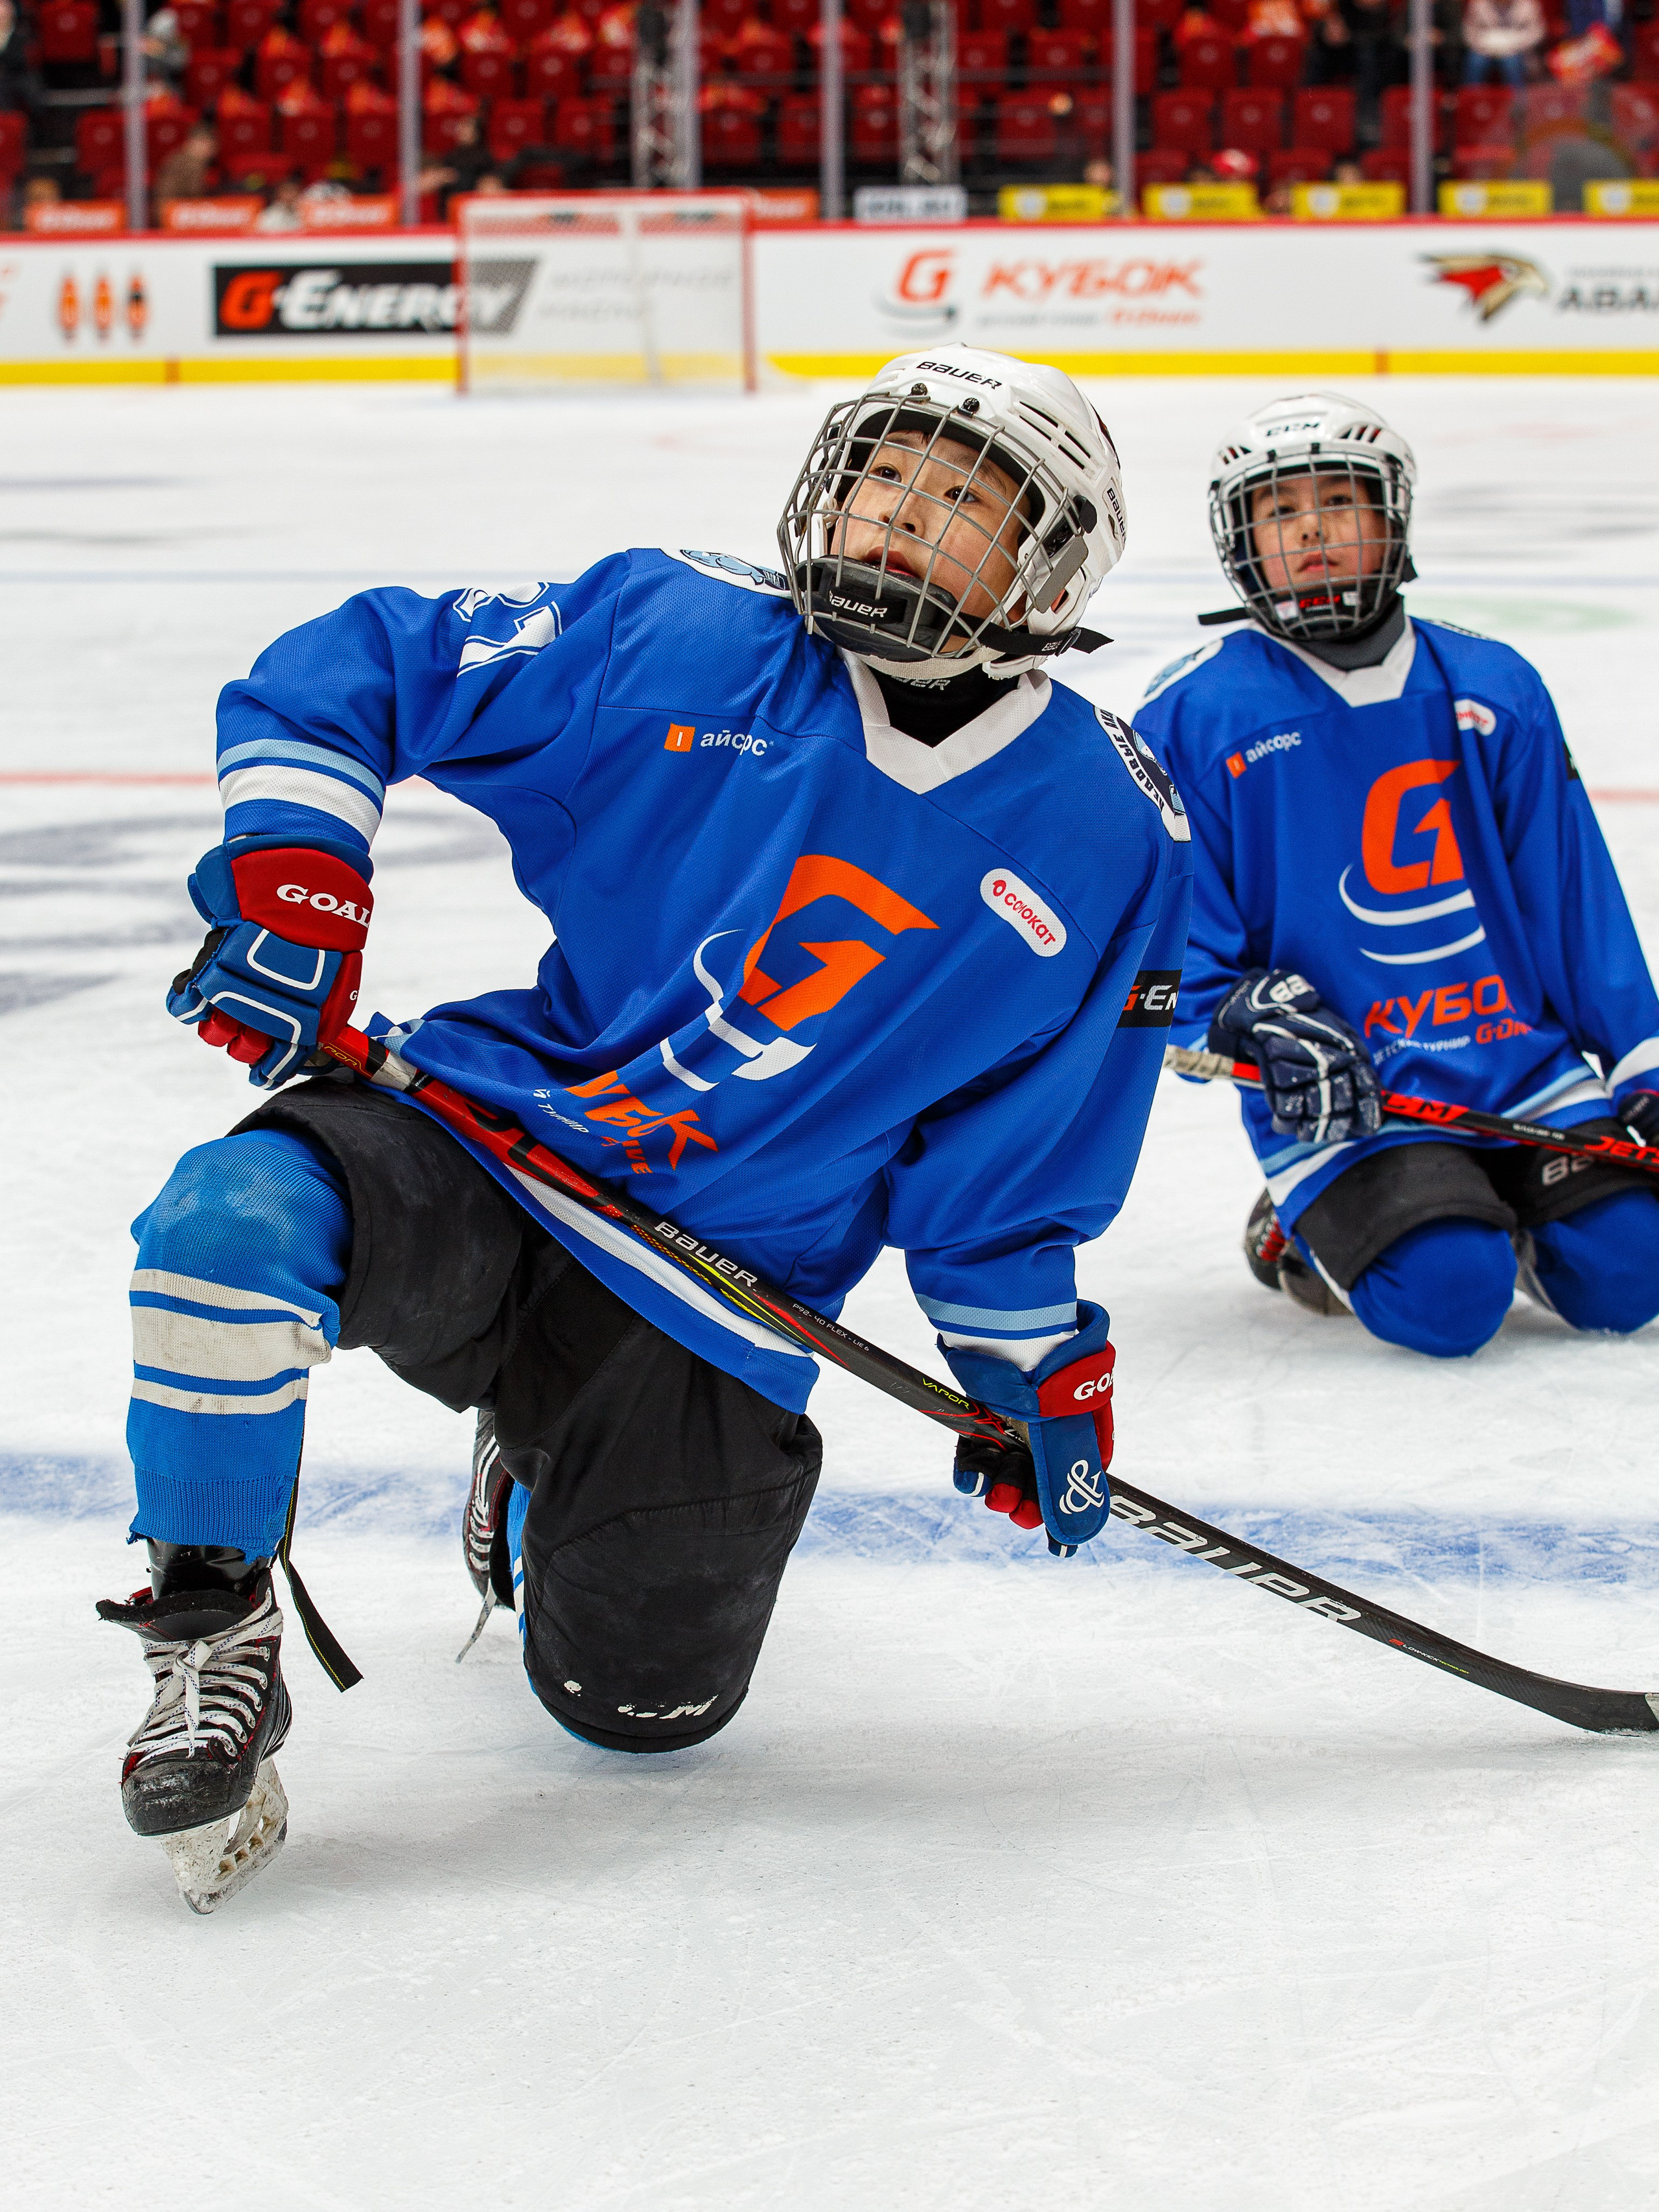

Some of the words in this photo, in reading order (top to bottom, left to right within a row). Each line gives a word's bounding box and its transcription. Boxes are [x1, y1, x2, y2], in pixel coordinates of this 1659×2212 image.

[980, 259, 1205, 303] КУБОК
[916, 361, 1003, 390] BAUER
[1266, 422, 1321, 437] CCM
[1246, 731, 1302, 763] айсорс
[1363, 974, 1516, 1040] КУБО
[654, 1221, 758, 1287] BAUER
[826, 1323, 848, 1339] FLEX
[853, 1340, 864, 1348] LIE
[922, 1377, 970, 1410] VAPOR
[1060, 1459, 1104, 1515] &
